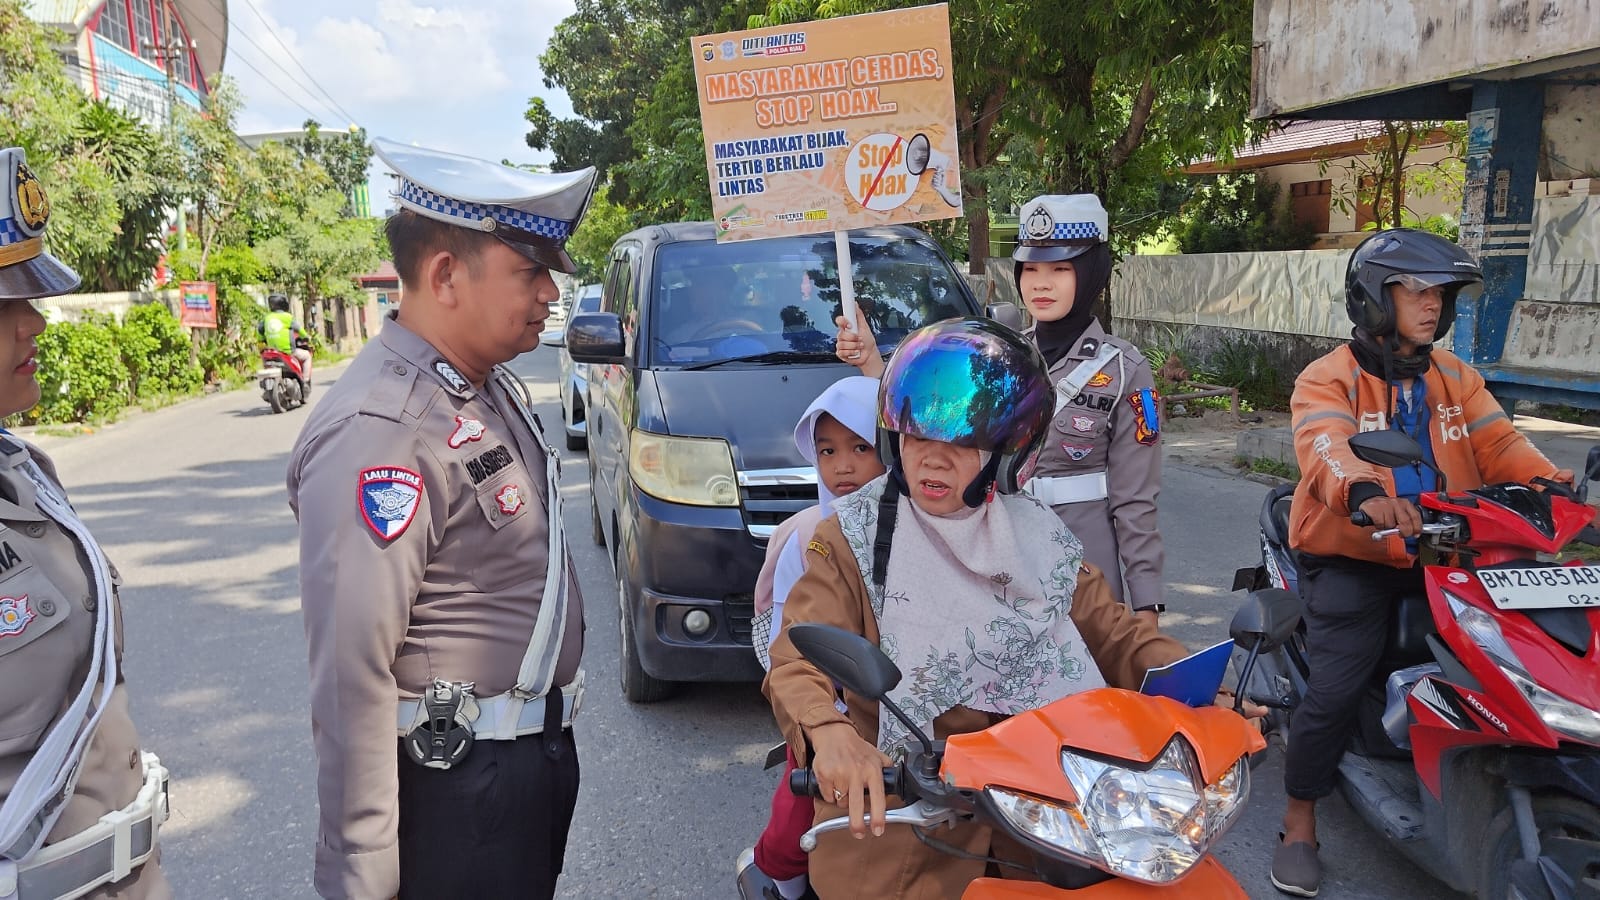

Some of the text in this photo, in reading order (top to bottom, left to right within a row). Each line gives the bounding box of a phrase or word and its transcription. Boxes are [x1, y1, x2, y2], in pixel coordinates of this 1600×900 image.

[769, 47, 788, 55] POLDA
[706, 49, 943, 102] MASYARAKAT CERDAS,
[757, 96, 812, 126] STOP
[714, 129, 849, 160] MASYARAKAT BIJAK,
[858, 142, 903, 169] Stop
[716, 152, 824, 178] TERTIB BERLALU
[719, 178, 764, 197] LINTAS
[859, 173, 907, 199] Hoax
[1071, 392, 1115, 412] OLRI
[364, 470, 420, 486] LALU LINTAS
[1466, 693, 1510, 733] HONDA
